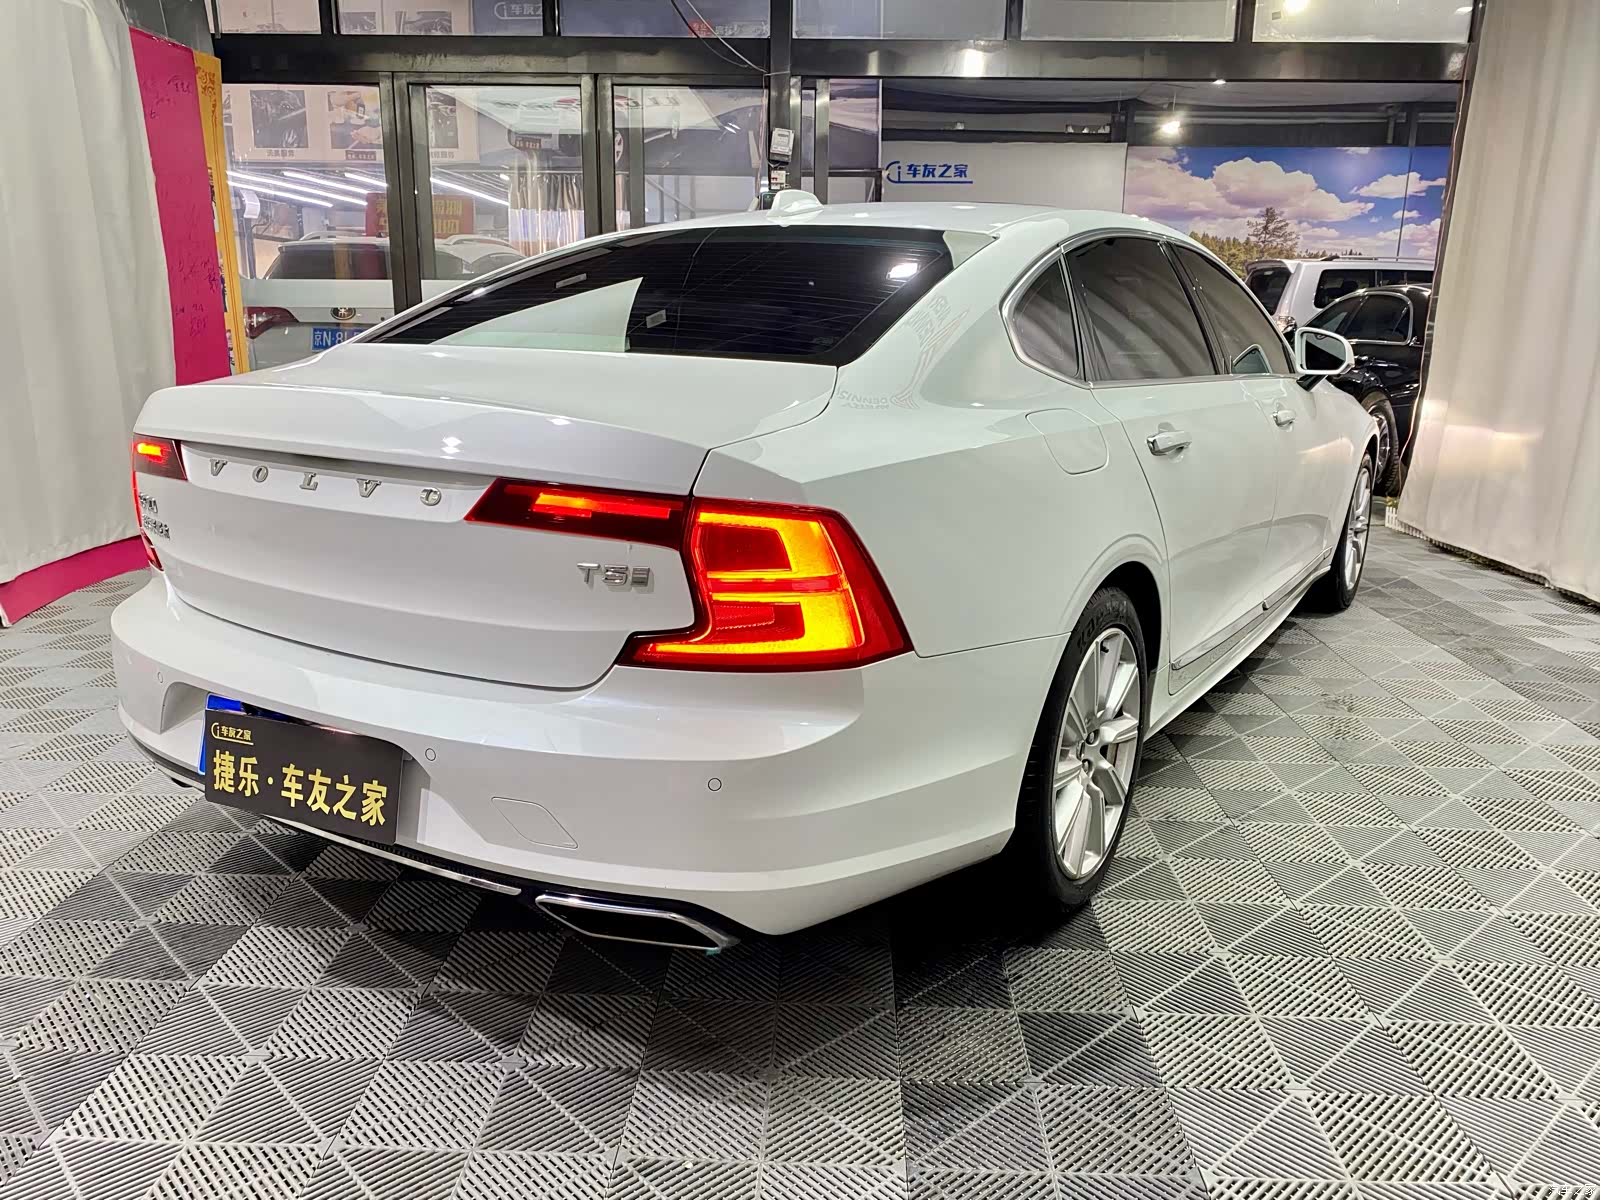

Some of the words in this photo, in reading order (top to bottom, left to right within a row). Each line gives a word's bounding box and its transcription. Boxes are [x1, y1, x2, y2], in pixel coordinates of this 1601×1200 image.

[906, 163, 969, 178] 车友之家
[209, 458, 443, 507] VOLVO
[220, 725, 252, 741] 车友之家
[213, 750, 387, 827] 捷乐·车友之家
